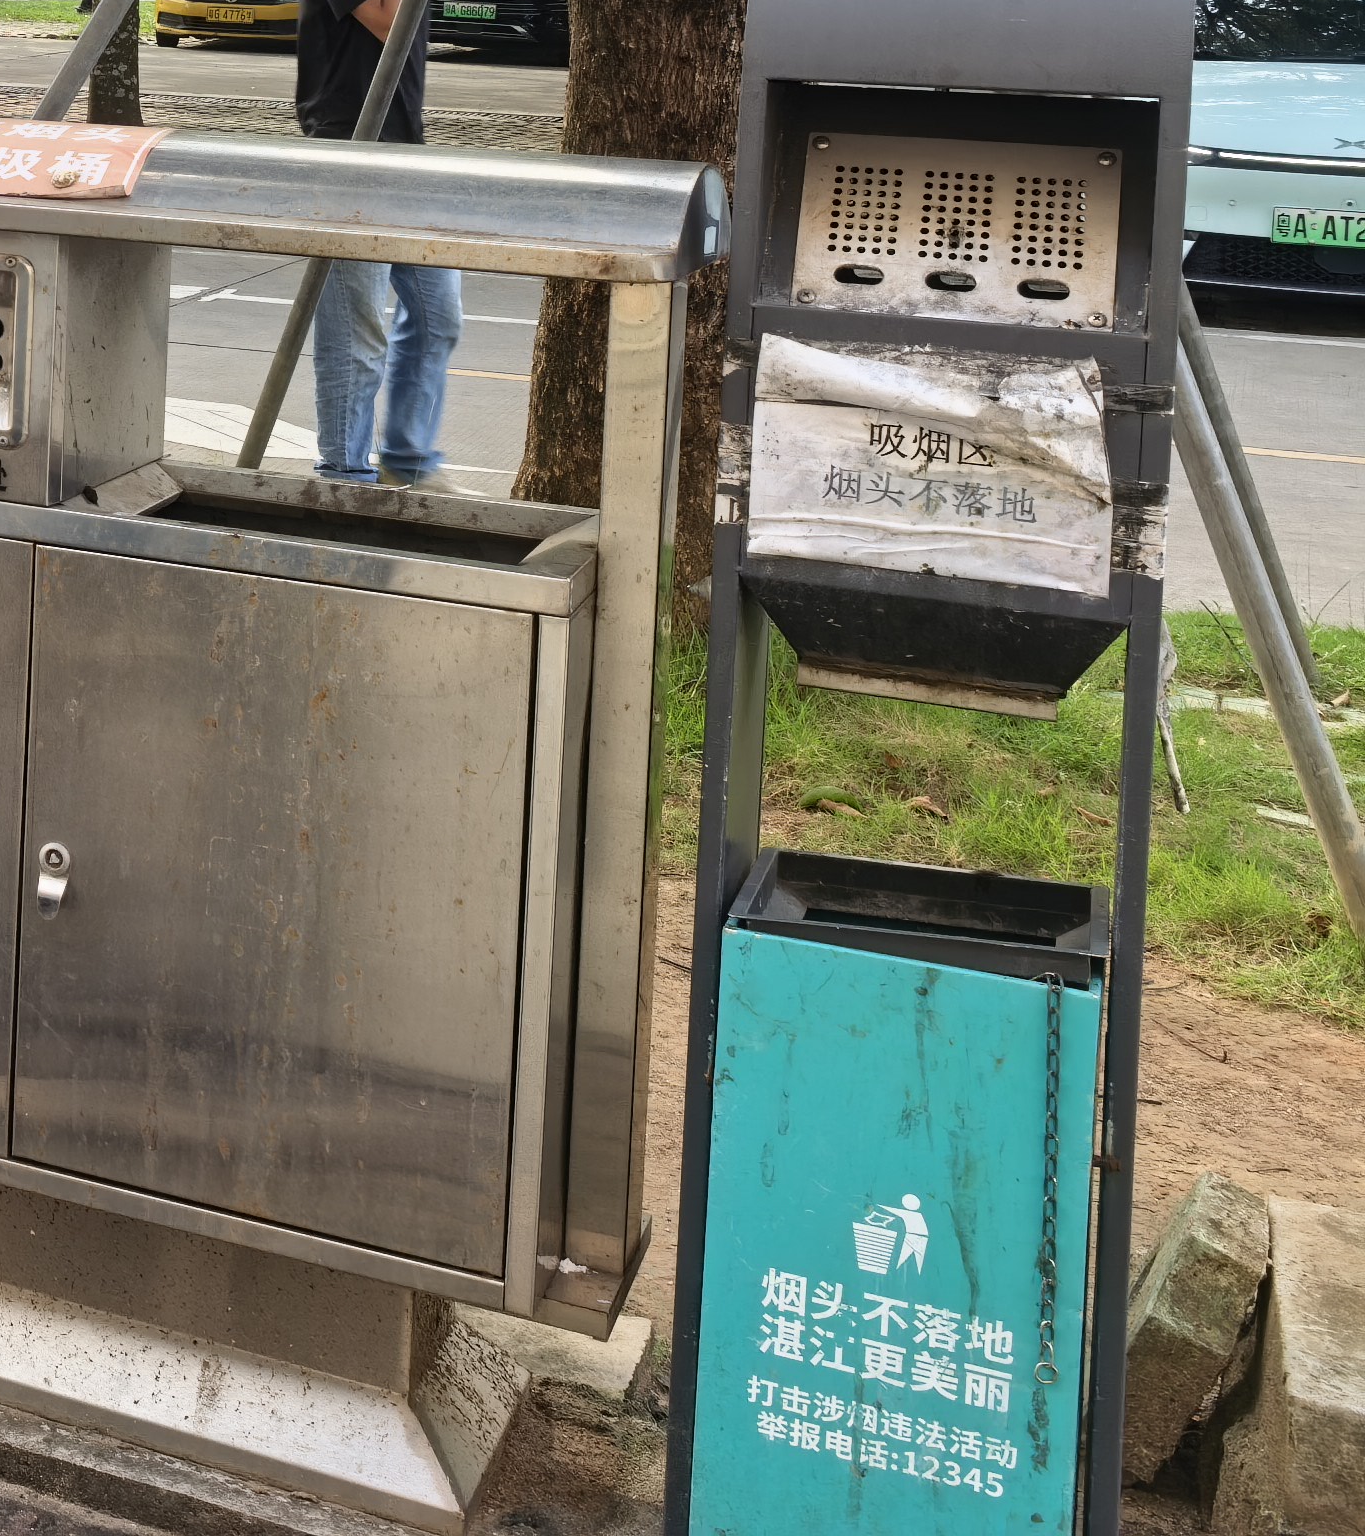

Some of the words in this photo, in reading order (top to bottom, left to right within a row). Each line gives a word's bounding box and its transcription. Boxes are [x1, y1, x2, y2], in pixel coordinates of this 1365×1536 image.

[870, 422, 994, 468] 吸烟区
[822, 463, 1038, 524] 烟头不落地
[758, 1312, 1014, 1414] 湛江更美丽
[760, 1266, 1016, 1366] 烟头不落地
[747, 1375, 1018, 1470] 打击涉烟违法活动
